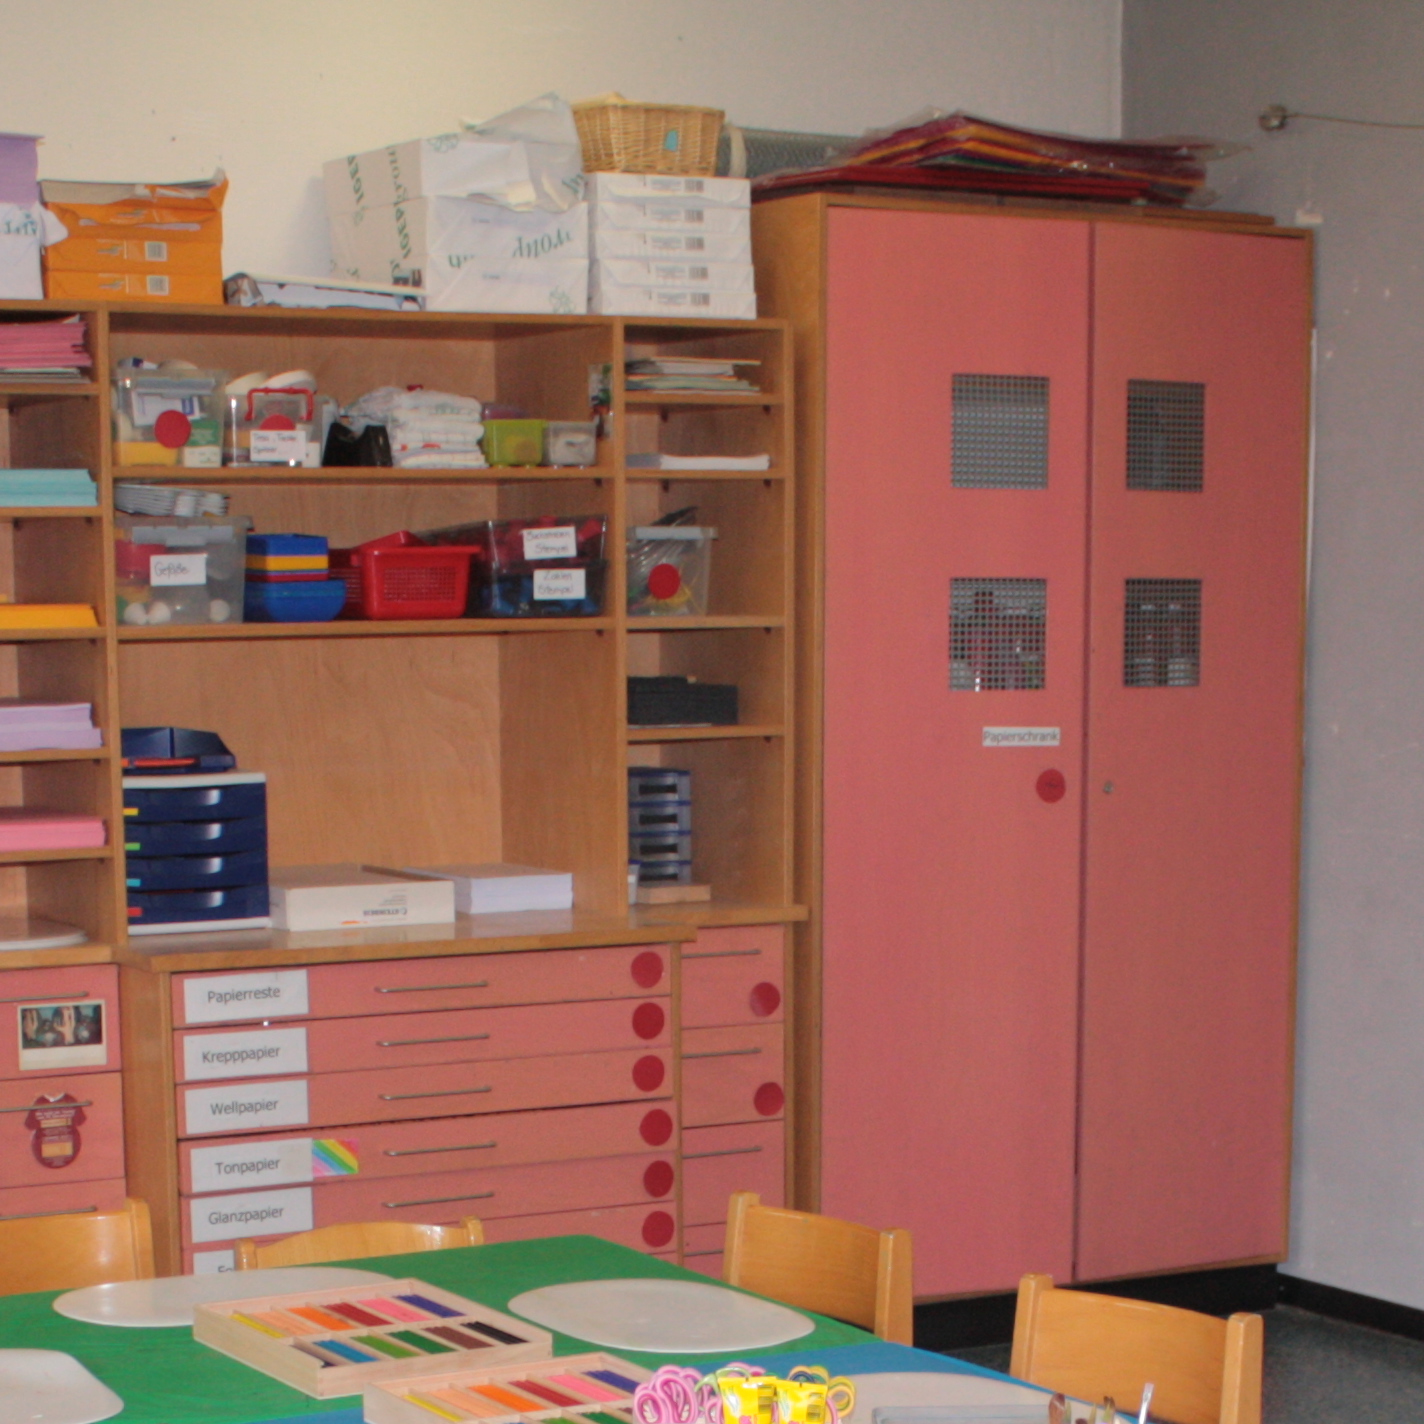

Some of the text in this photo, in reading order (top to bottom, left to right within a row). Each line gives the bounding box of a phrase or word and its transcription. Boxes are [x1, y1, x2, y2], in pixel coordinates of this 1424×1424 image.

[983, 730, 1061, 745] Papierschrank
[207, 986, 281, 1005] Papierreste
[202, 1046, 281, 1064] Krepppapier
[210, 1099, 279, 1116] Wellpapier
[215, 1158, 281, 1176] Tonpapier
[208, 1205, 284, 1225] Glanzpapier
